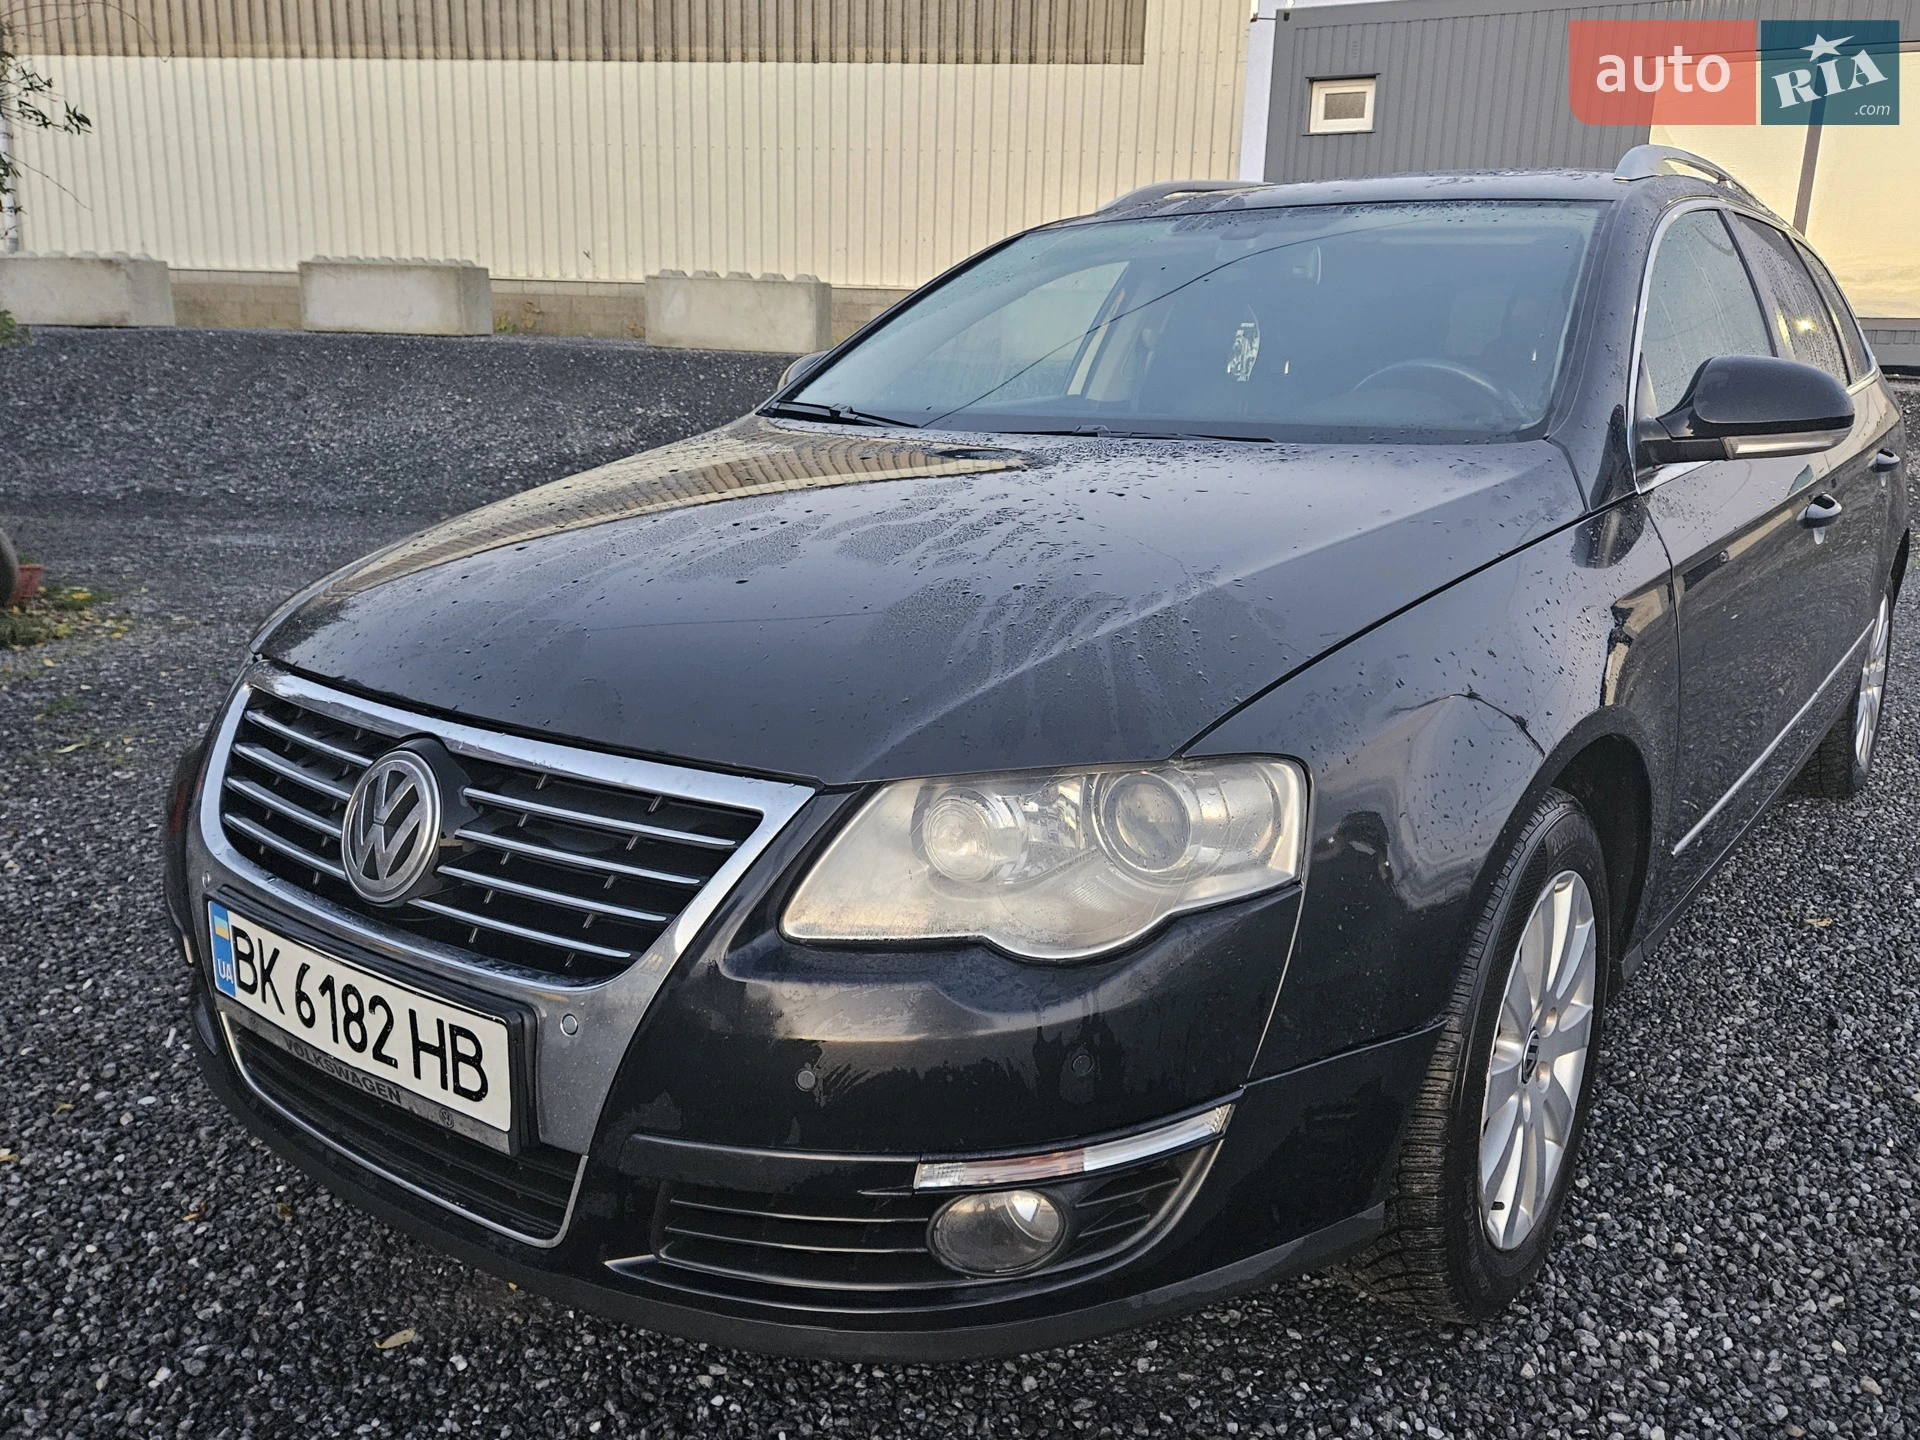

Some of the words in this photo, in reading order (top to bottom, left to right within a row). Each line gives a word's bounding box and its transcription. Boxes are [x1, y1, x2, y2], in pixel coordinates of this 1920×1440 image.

[217, 960, 235, 985] UA
[231, 924, 285, 1015] BK
[295, 962, 399, 1070] 6182
[408, 1008, 489, 1102] HB
[282, 1035, 402, 1104] VOLKSWAGEN
